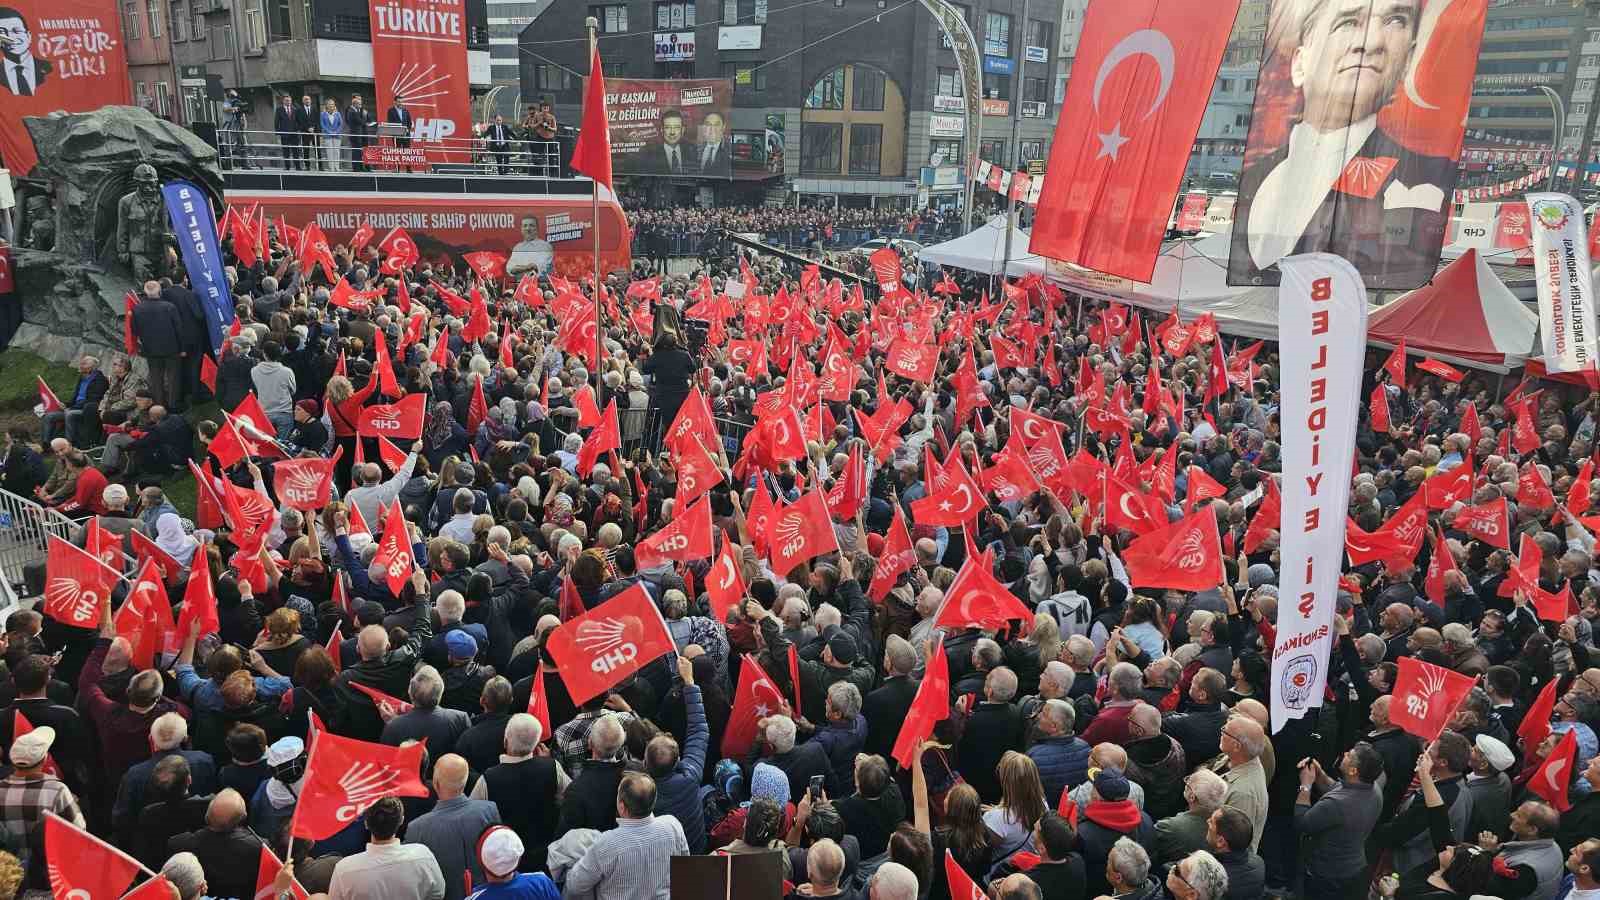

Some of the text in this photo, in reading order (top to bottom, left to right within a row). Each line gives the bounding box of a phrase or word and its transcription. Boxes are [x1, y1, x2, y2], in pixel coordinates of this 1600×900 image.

[375, 2, 460, 36] TÜRKİYE
[38, 29, 117, 57] ÖZGÜR-
[59, 54, 106, 79] LÜK!
[621, 91, 656, 106] BAŞKAN
[619, 106, 660, 121] DEĞİLDİR!
[411, 118, 456, 143] HP
[382, 148, 425, 156] CUMHURİYET
[382, 154, 426, 163] HALK PARTİSİ
[316, 212, 515, 231] MİLLET İRADESİNE SAHİP ÇIKIYOR
